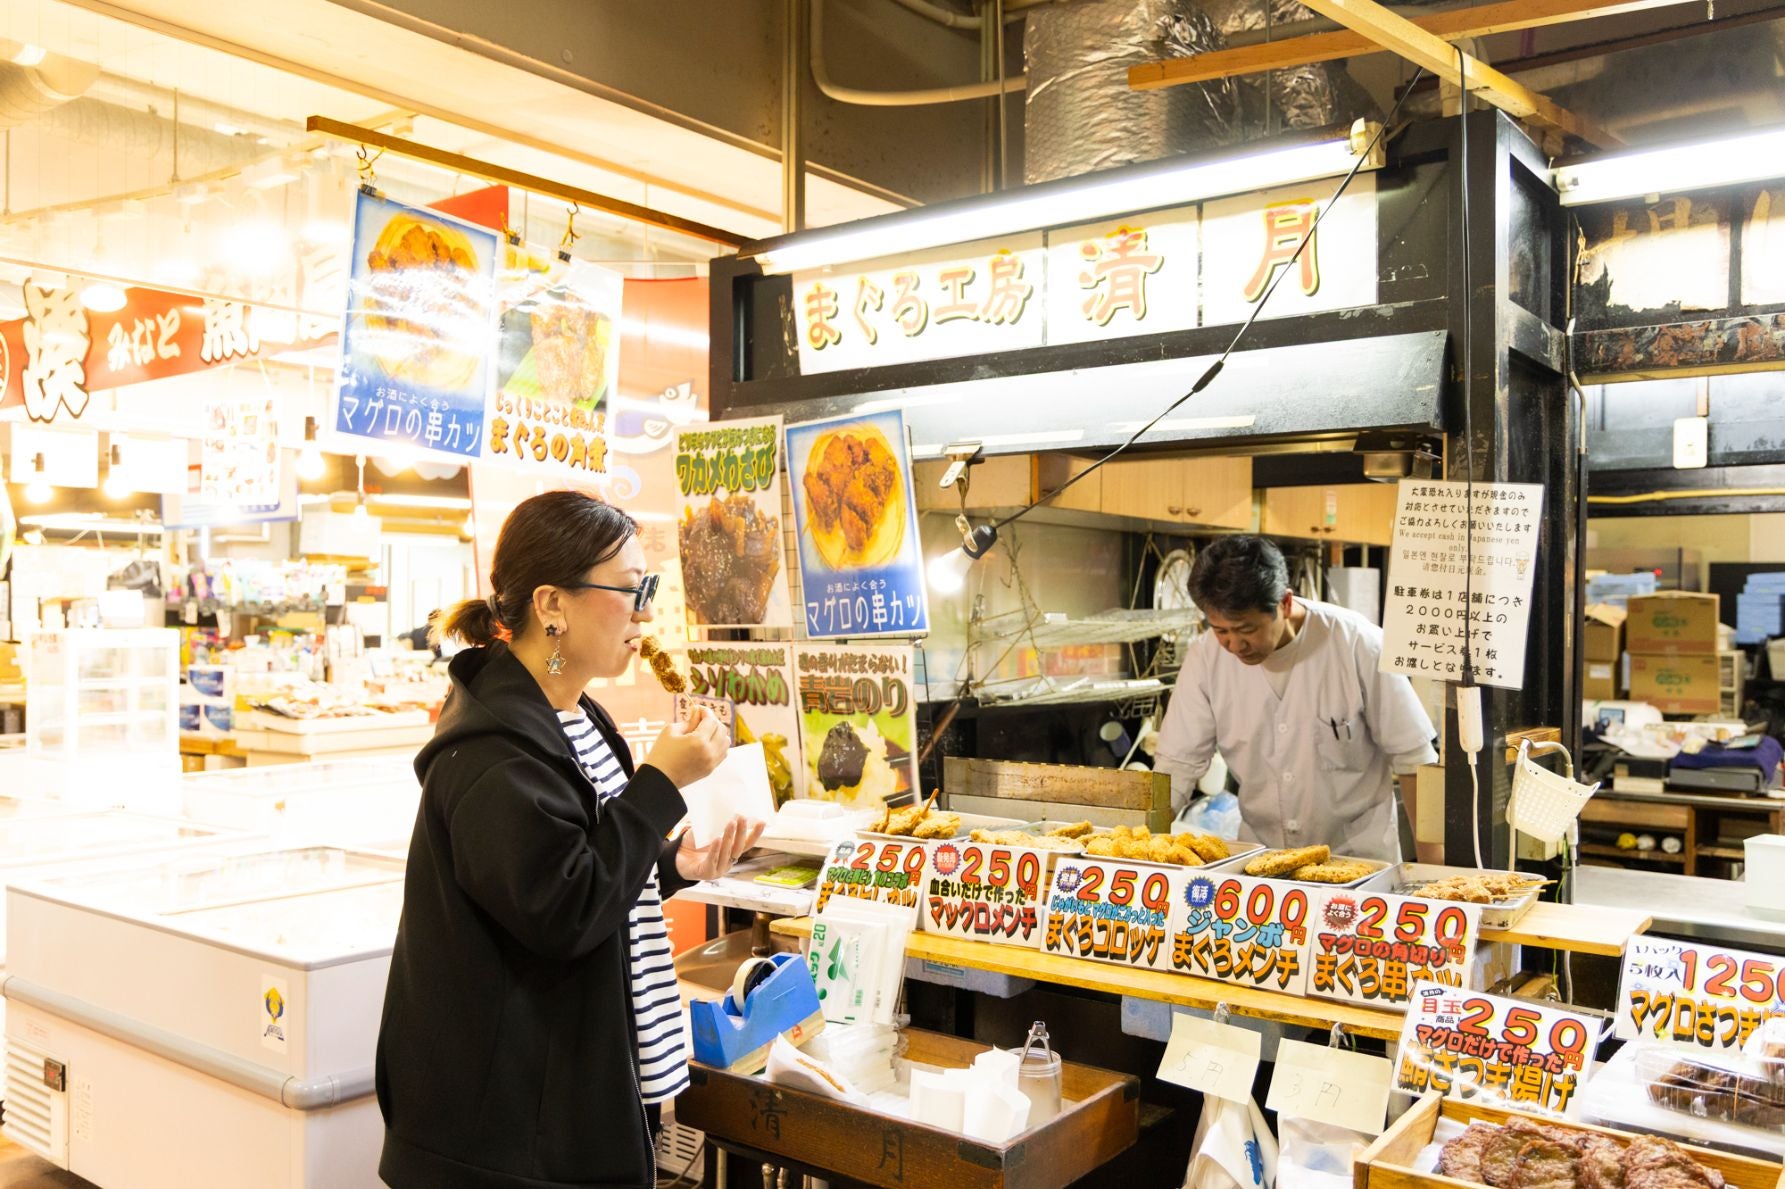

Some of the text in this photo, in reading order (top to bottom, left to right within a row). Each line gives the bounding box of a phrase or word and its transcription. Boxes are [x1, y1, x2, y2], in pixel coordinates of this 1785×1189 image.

[806, 249, 1033, 350] まぐろ工房
[376, 387, 450, 411] お酒によく合う
[342, 396, 480, 452] マグロの串カツ
[490, 416, 608, 474] まぐろの角煮
[676, 443, 776, 496] ワカメわさび
[1399, 529, 1409, 538] We
[1412, 531, 1436, 540] accept
[1438, 532, 1455, 540] cash
[826, 579, 887, 594] お酒によく合う
[807, 590, 922, 633] マグロの串カツ
[799, 674, 908, 718] 青岩のり
[929, 878, 1026, 905] 血合いだけで作った
[928, 897, 1038, 941] マックロメンチ
[1046, 910, 1166, 967] まぐろコロッケ
[1186, 910, 1286, 949] ジャンボ
[1172, 930, 1300, 990] まぐろメンチ
[1318, 932, 1448, 969] マグロの角切り
[1679, 949, 1785, 1004] 125
[1421, 997, 1462, 1014] 目玉
[1630, 990, 1785, 1051] マグロさつま
[1416, 1023, 1565, 1075] マグロだけで作った
